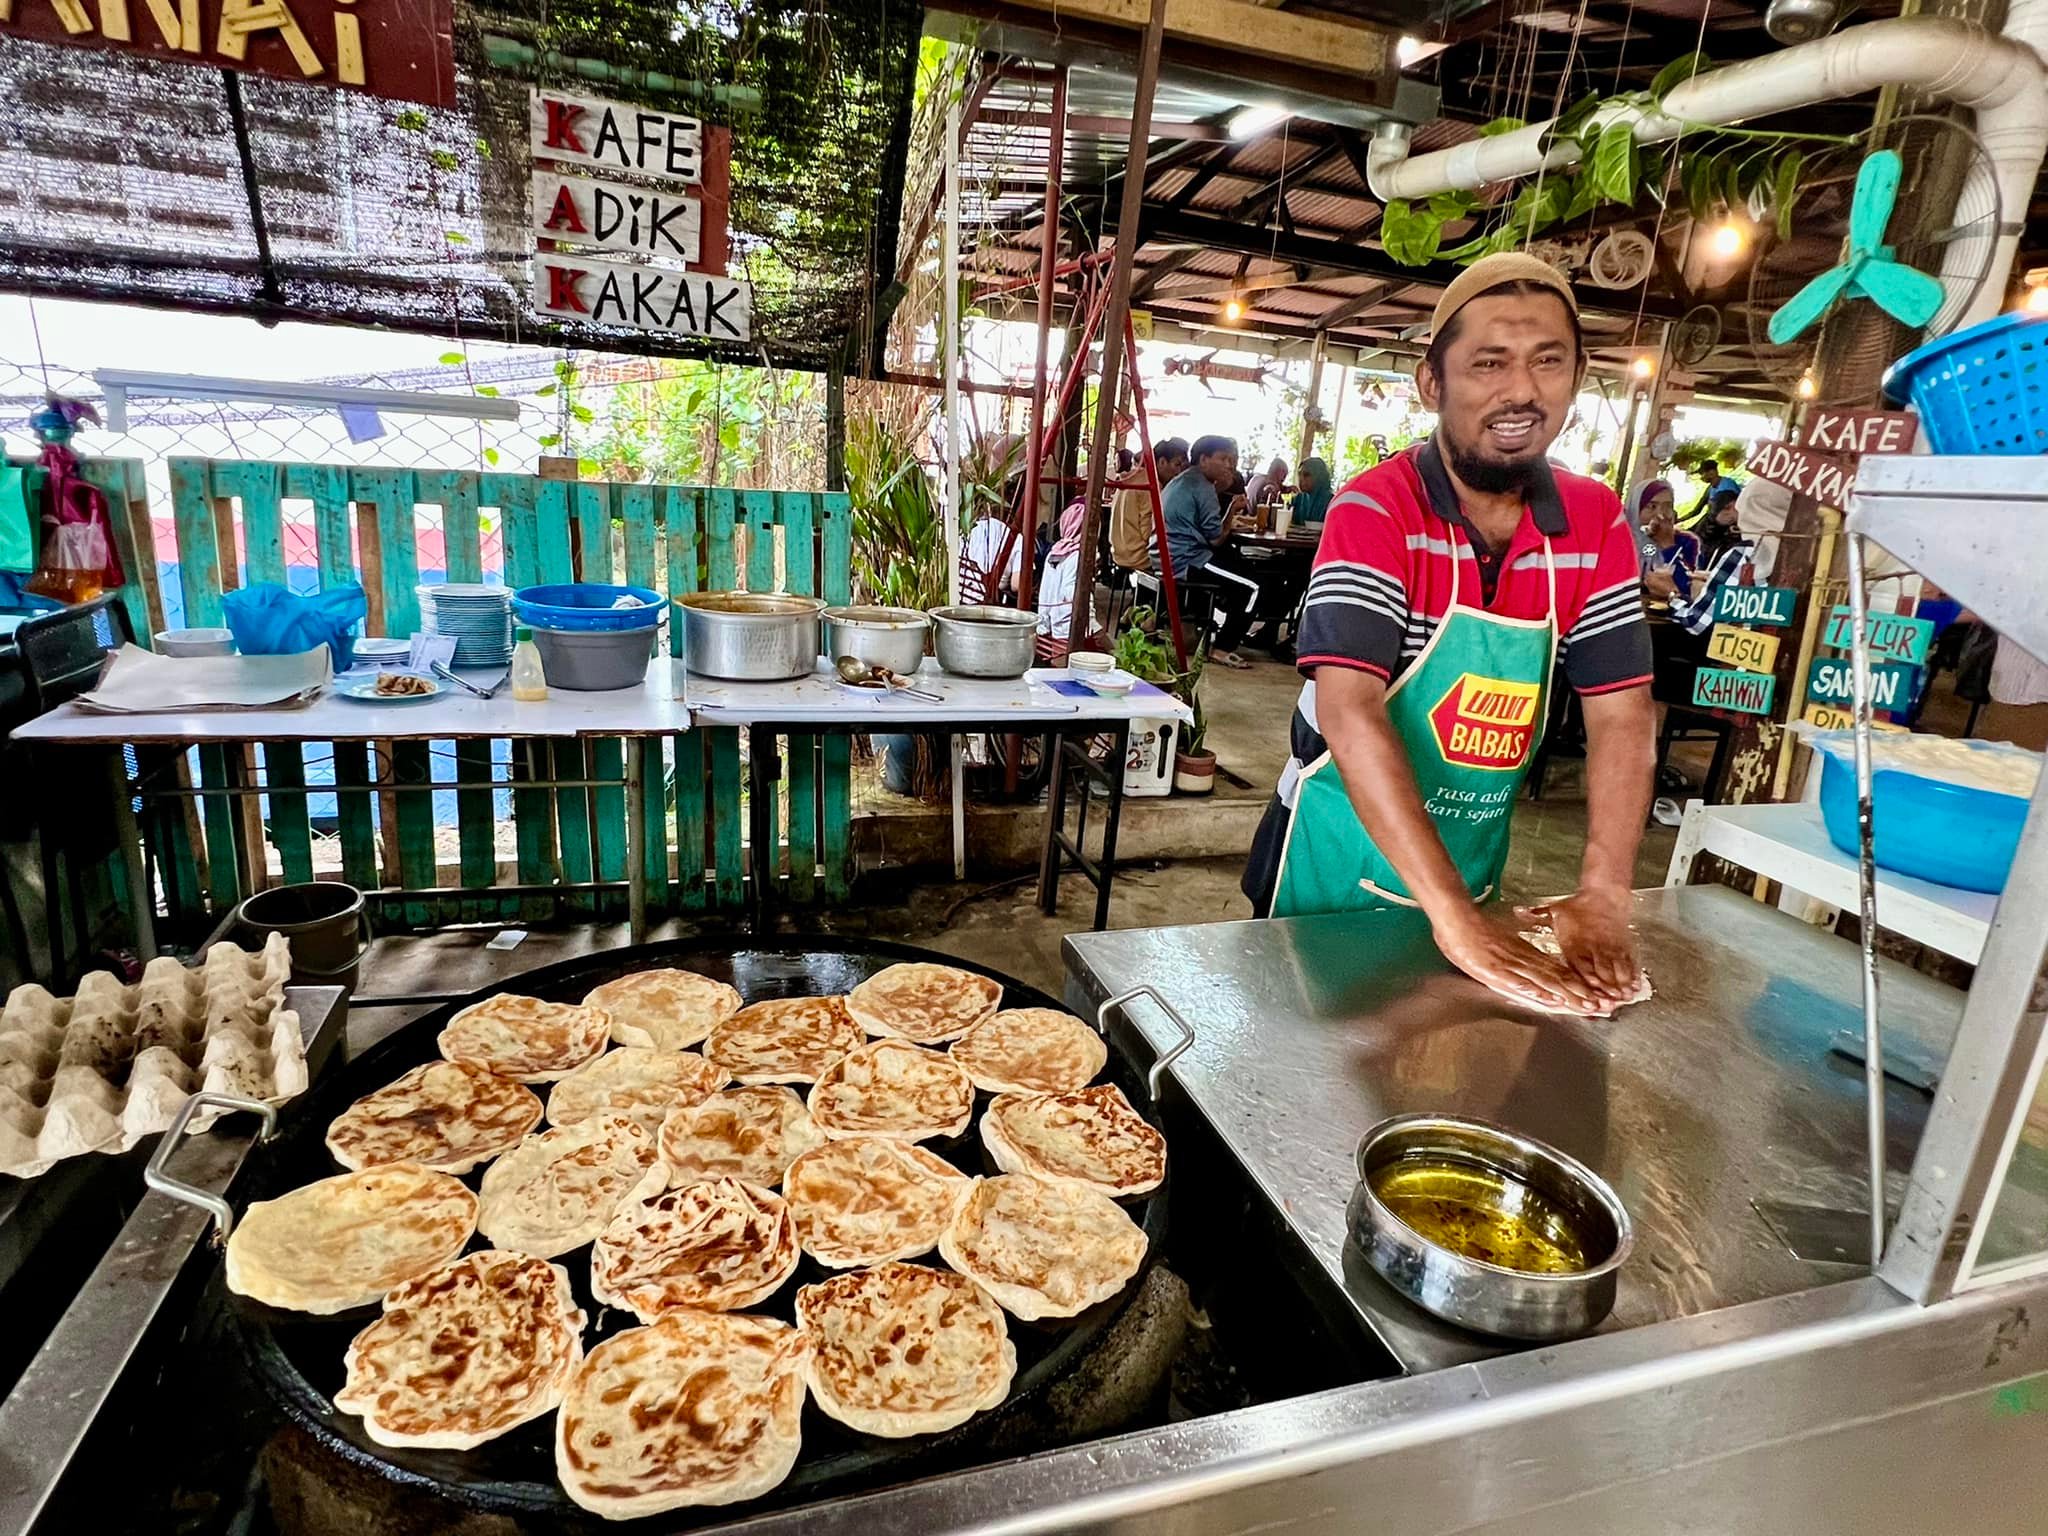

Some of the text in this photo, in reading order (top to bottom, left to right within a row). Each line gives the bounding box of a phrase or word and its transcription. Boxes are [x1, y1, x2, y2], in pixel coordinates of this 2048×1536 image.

[542, 99, 697, 177] KAFE
[545, 265, 741, 337] KAKAK
[1808, 413, 1904, 452] KAFE
[1805, 463, 1856, 512] KAK
[1720, 588, 1786, 622] DHOLL
[1832, 613, 1917, 659] TLUR
[1812, 665, 1900, 705] SARIN
[1436, 784, 1511, 803] rasa asli
